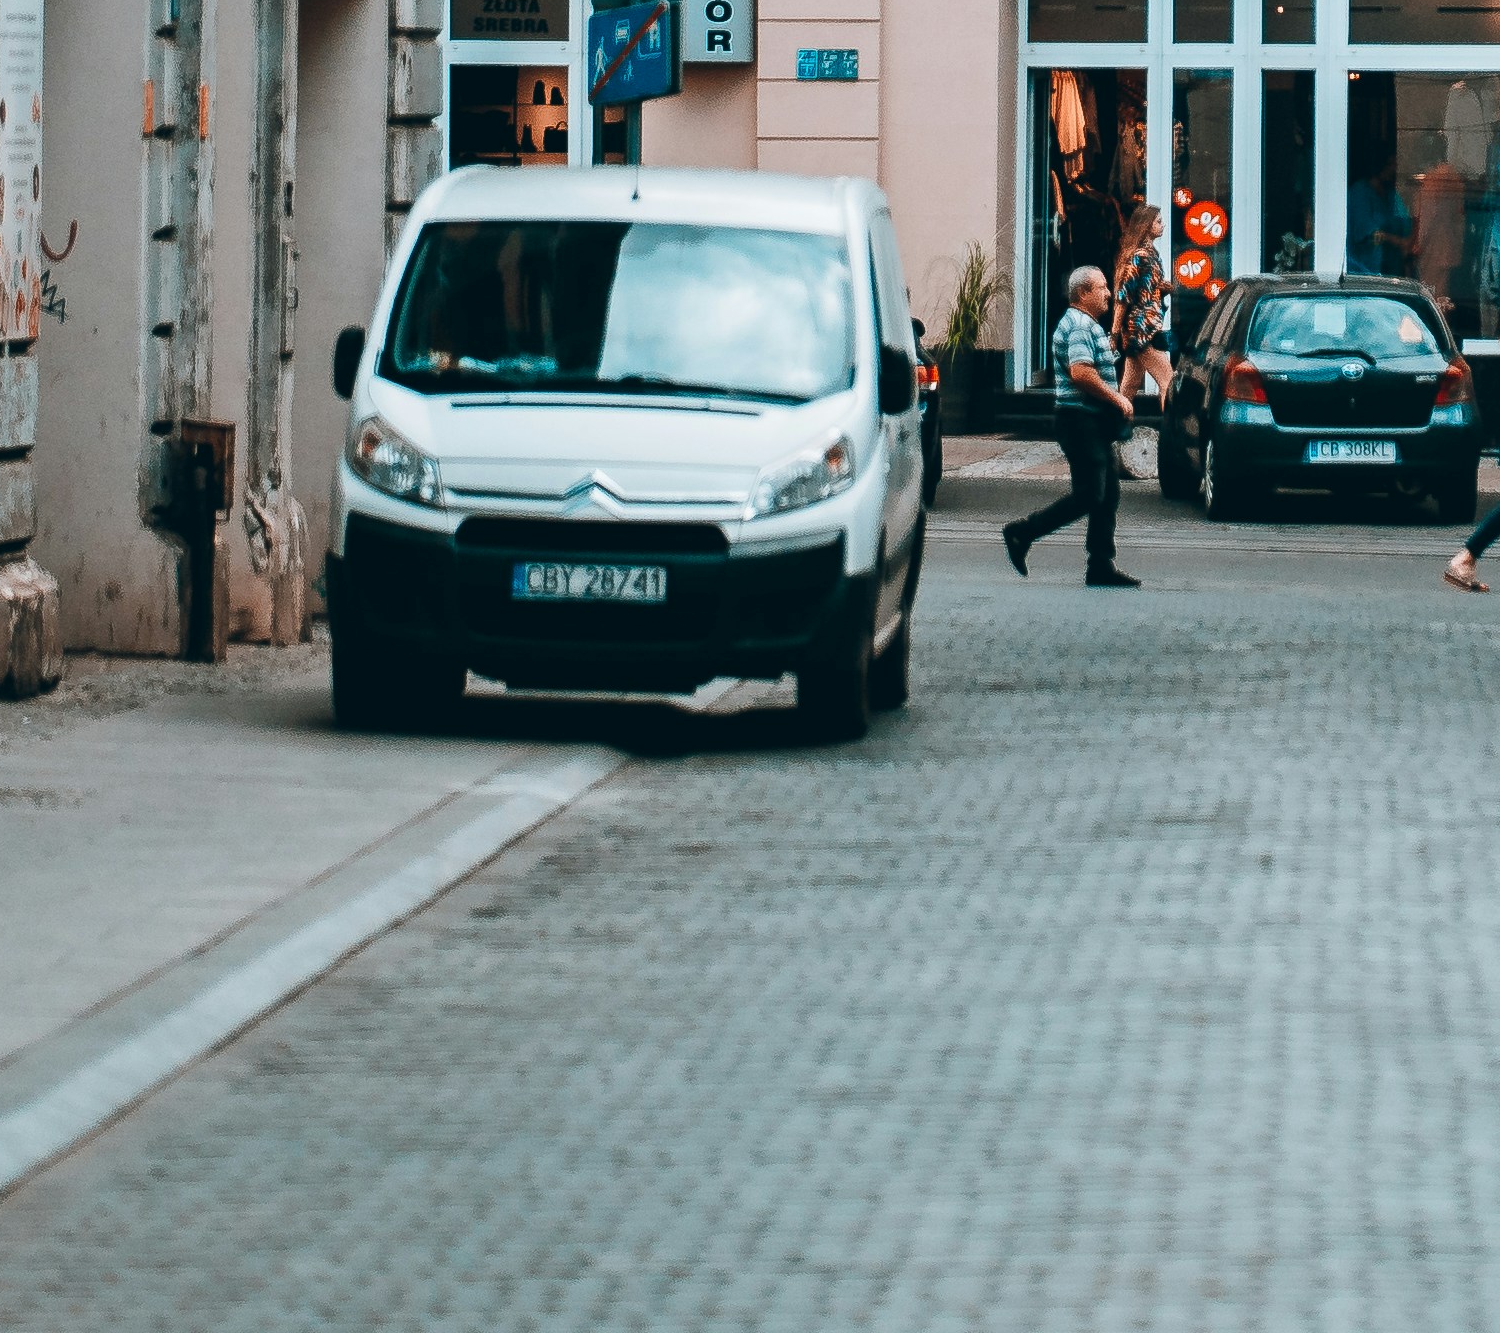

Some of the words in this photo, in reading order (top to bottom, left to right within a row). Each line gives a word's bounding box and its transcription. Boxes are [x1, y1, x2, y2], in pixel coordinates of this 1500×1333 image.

[472, 16, 549, 34] SREBRA
[1320, 441, 1340, 457] CB
[1344, 441, 1390, 457] 308KL
[527, 563, 571, 598] CBY
